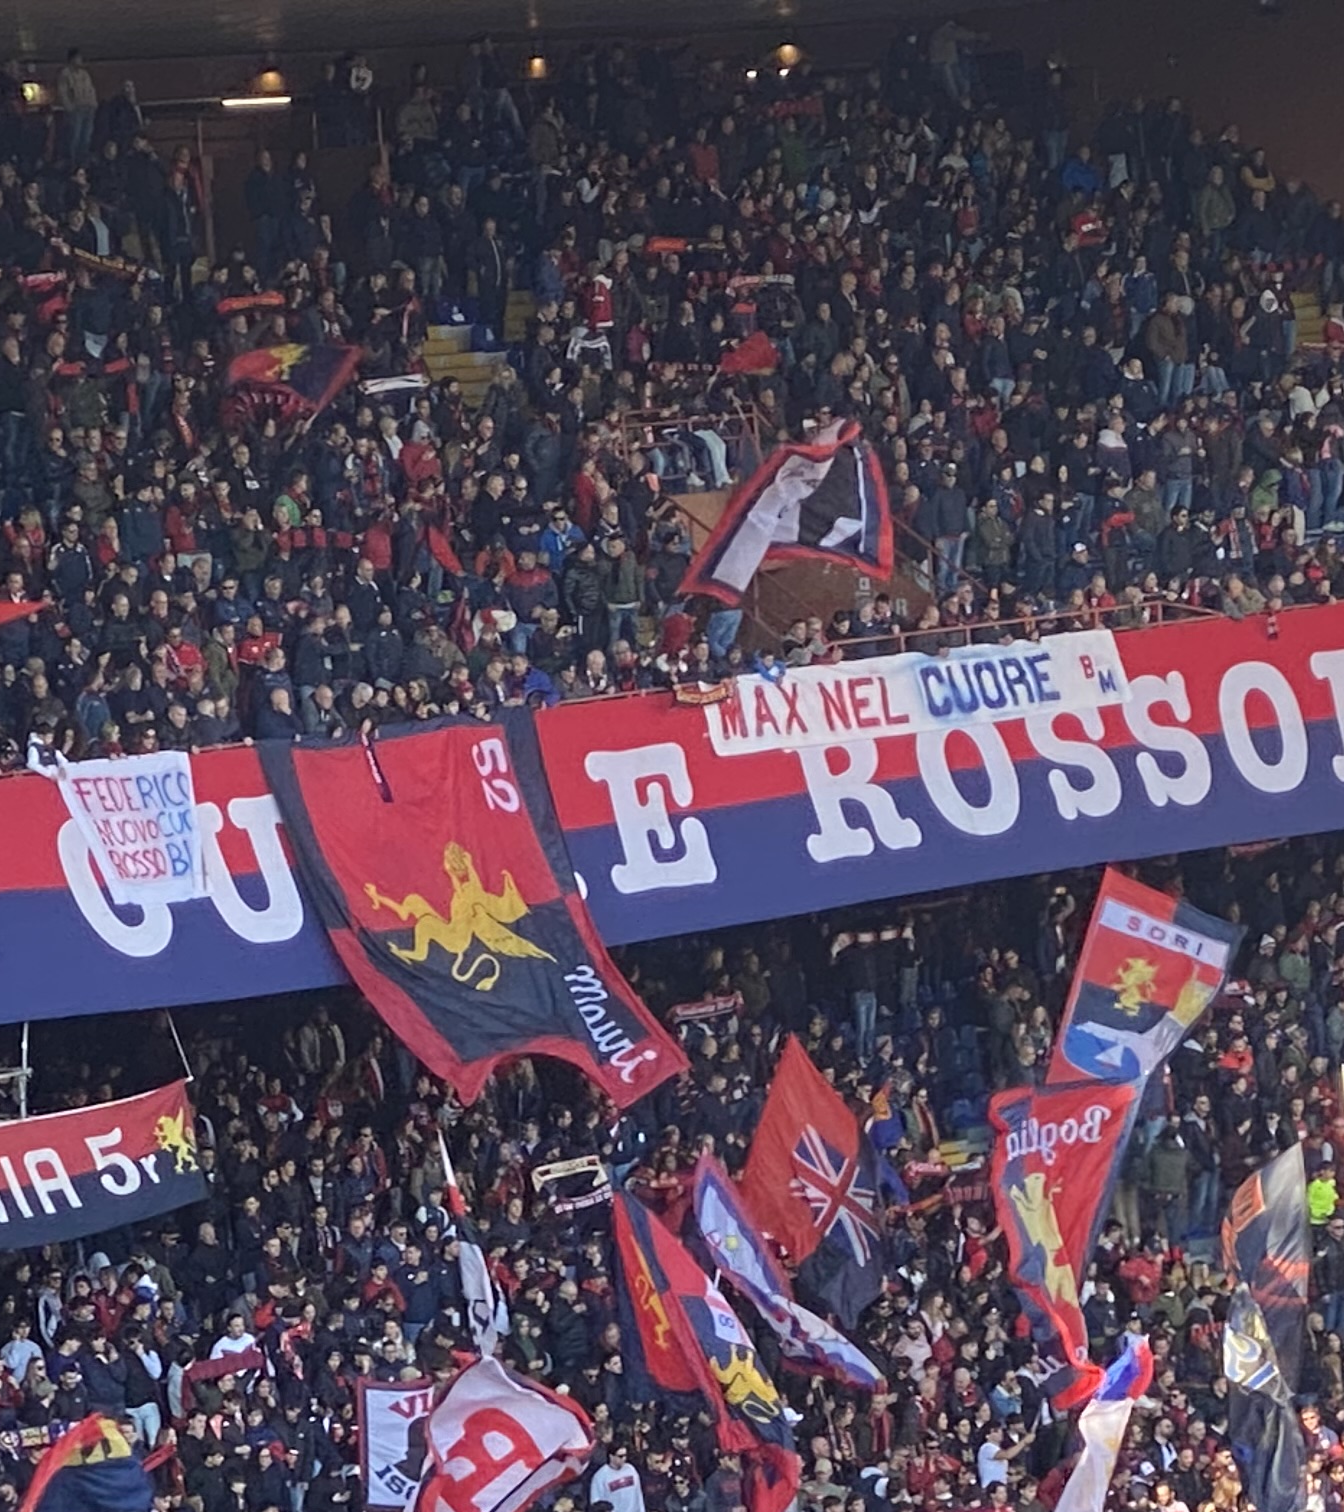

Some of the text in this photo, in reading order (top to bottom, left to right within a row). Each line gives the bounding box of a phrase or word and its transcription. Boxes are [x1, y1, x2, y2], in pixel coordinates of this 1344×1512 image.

[720, 690, 801, 740] MAX
[822, 676, 910, 731] NEL
[919, 649, 1059, 718] CUORE
[1126, 917, 1203, 958] SORI
